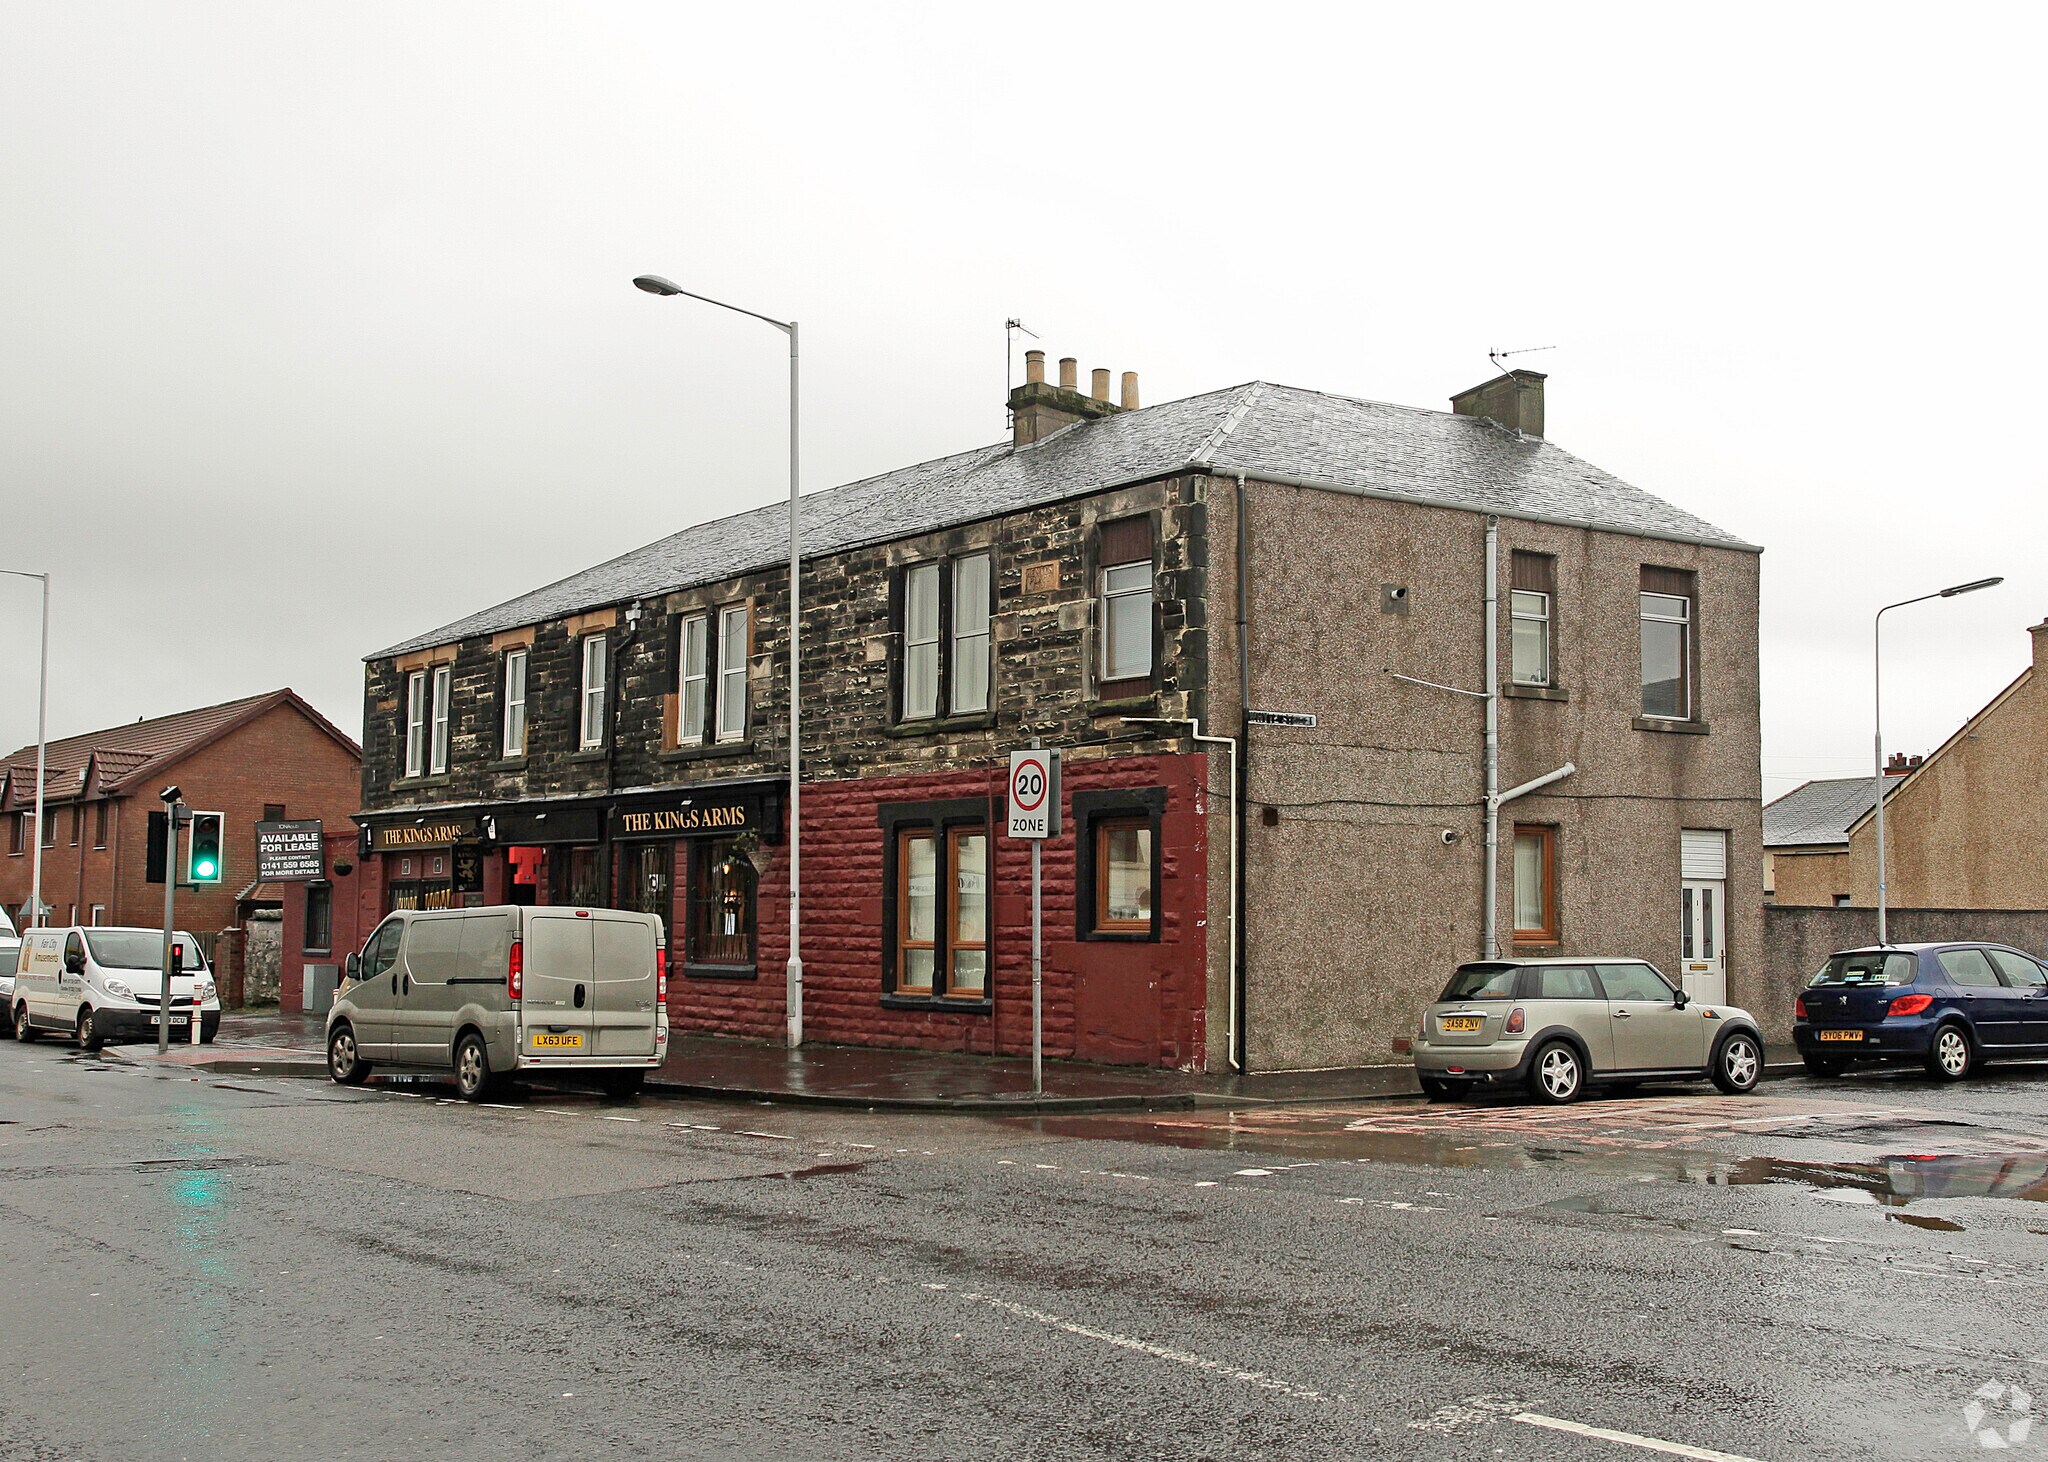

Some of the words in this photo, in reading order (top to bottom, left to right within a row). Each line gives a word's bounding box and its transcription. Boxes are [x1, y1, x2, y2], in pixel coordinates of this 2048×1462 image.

[1018, 774, 1042, 795] 20
[623, 813, 652, 832] THE
[653, 810, 699, 829] KINGS
[701, 805, 746, 827] ARMS
[1012, 819, 1044, 832] ZONE
[260, 833, 319, 843] AVAILABLE
[383, 829, 402, 845] THE
[403, 825, 432, 843] KINGS
[434, 824, 462, 841] ARMS
[260, 843, 282, 853] FOR
[285, 842, 319, 852] LEASE
[261, 862, 281, 870] 0141
[283, 861, 298, 869] 559
[300, 860, 320, 868] 6585
[537, 1036, 560, 1045] LX63
[562, 1036, 578, 1045] UFE
[1823, 1031, 1841, 1039] SY06
